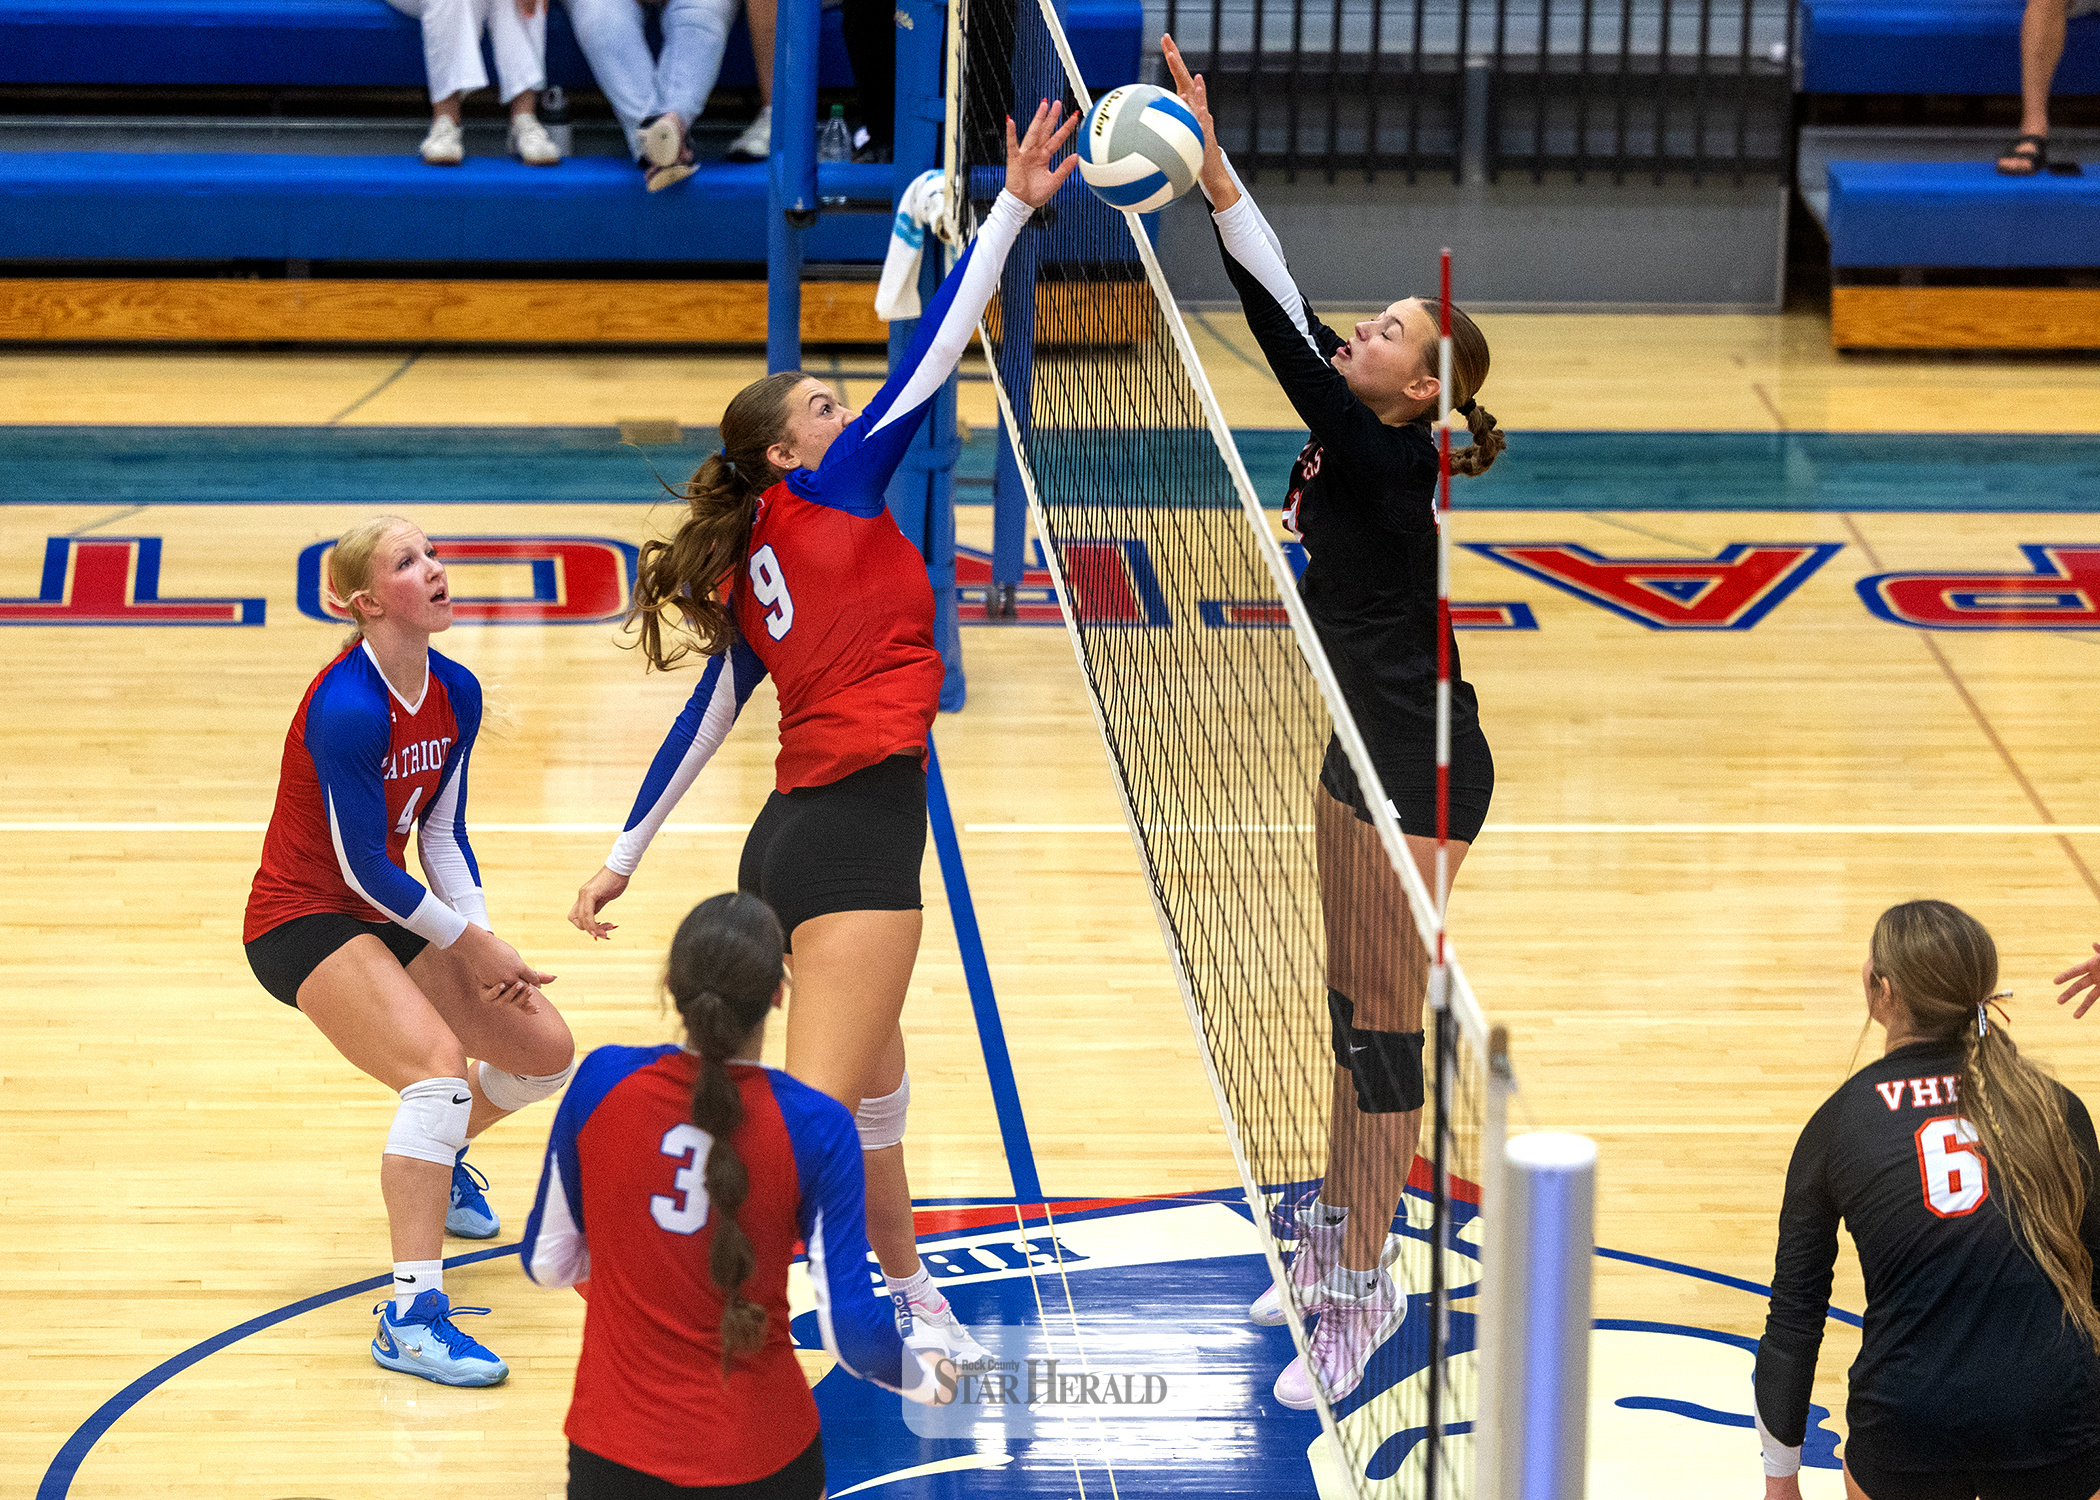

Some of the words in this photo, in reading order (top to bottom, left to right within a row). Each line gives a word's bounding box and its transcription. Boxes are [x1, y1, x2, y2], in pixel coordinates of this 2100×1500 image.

[749, 542, 795, 643] 9
[393, 785, 424, 835] 4
[649, 1122, 716, 1236] 3
[1913, 1113, 1989, 1219] 6
